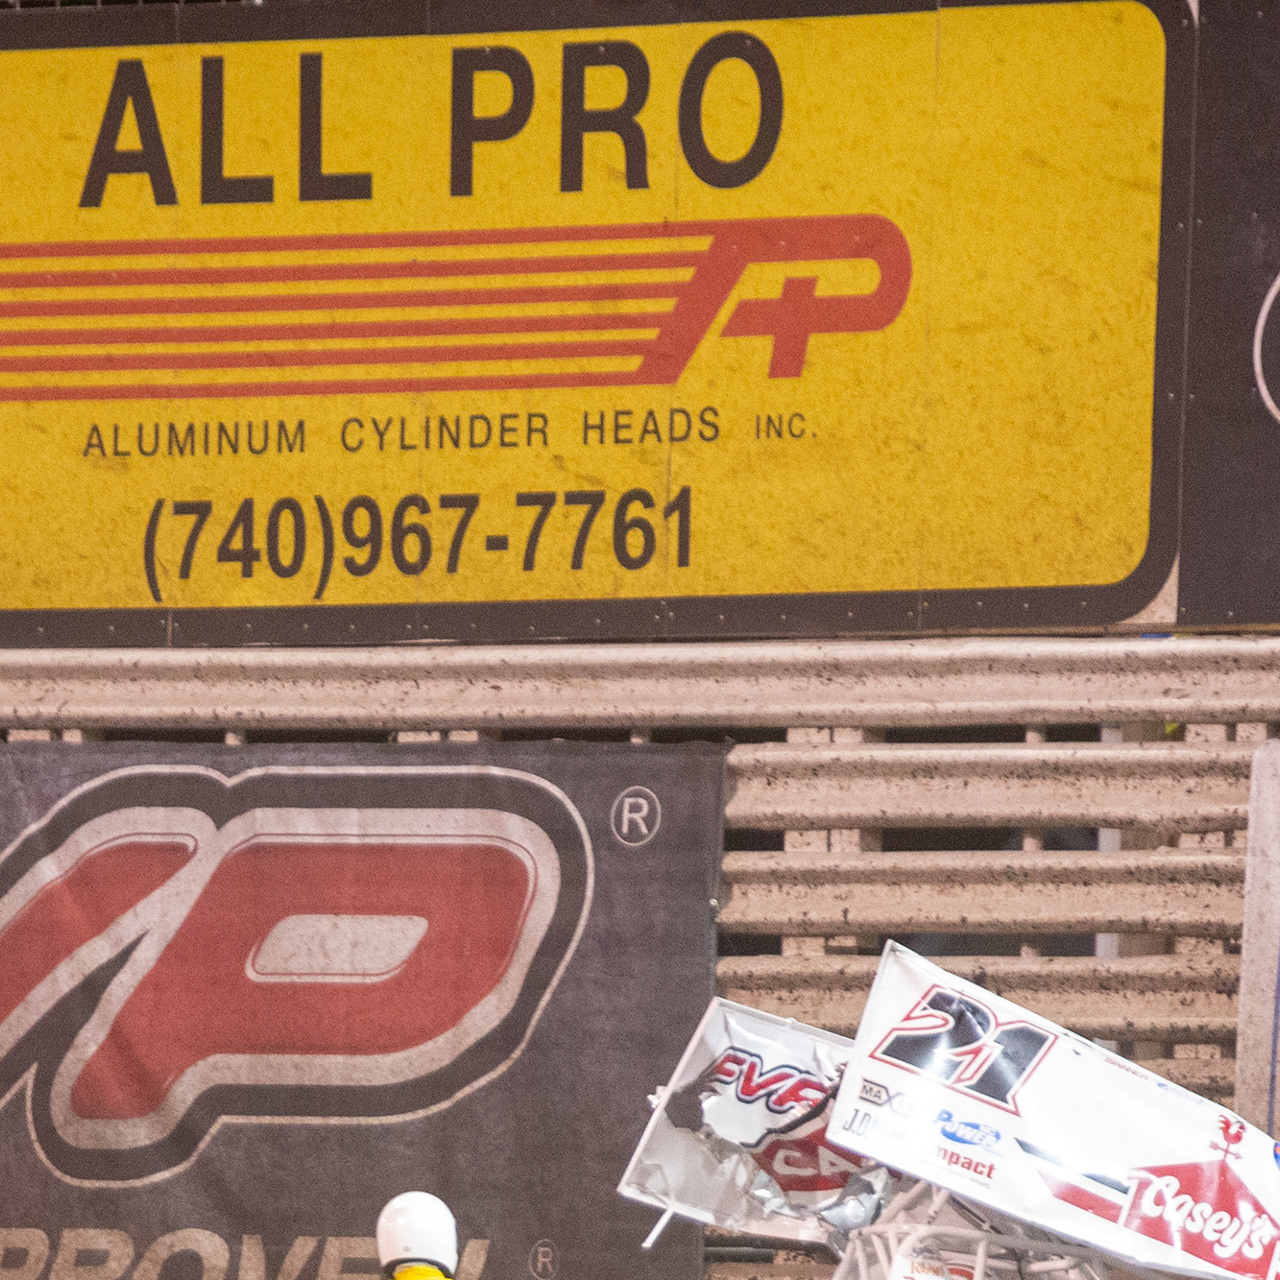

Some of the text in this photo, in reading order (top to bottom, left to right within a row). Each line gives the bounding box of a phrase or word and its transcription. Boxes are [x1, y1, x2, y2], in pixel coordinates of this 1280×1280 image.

[78, 30, 786, 209] ALL PRO
[82, 407, 818, 460] ALUMINUM CYLINDER HEADS INC.
[141, 486, 696, 602] (740)967-7761
[869, 982, 1060, 1118] 21
[1141, 1175, 1274, 1261] Casey's
